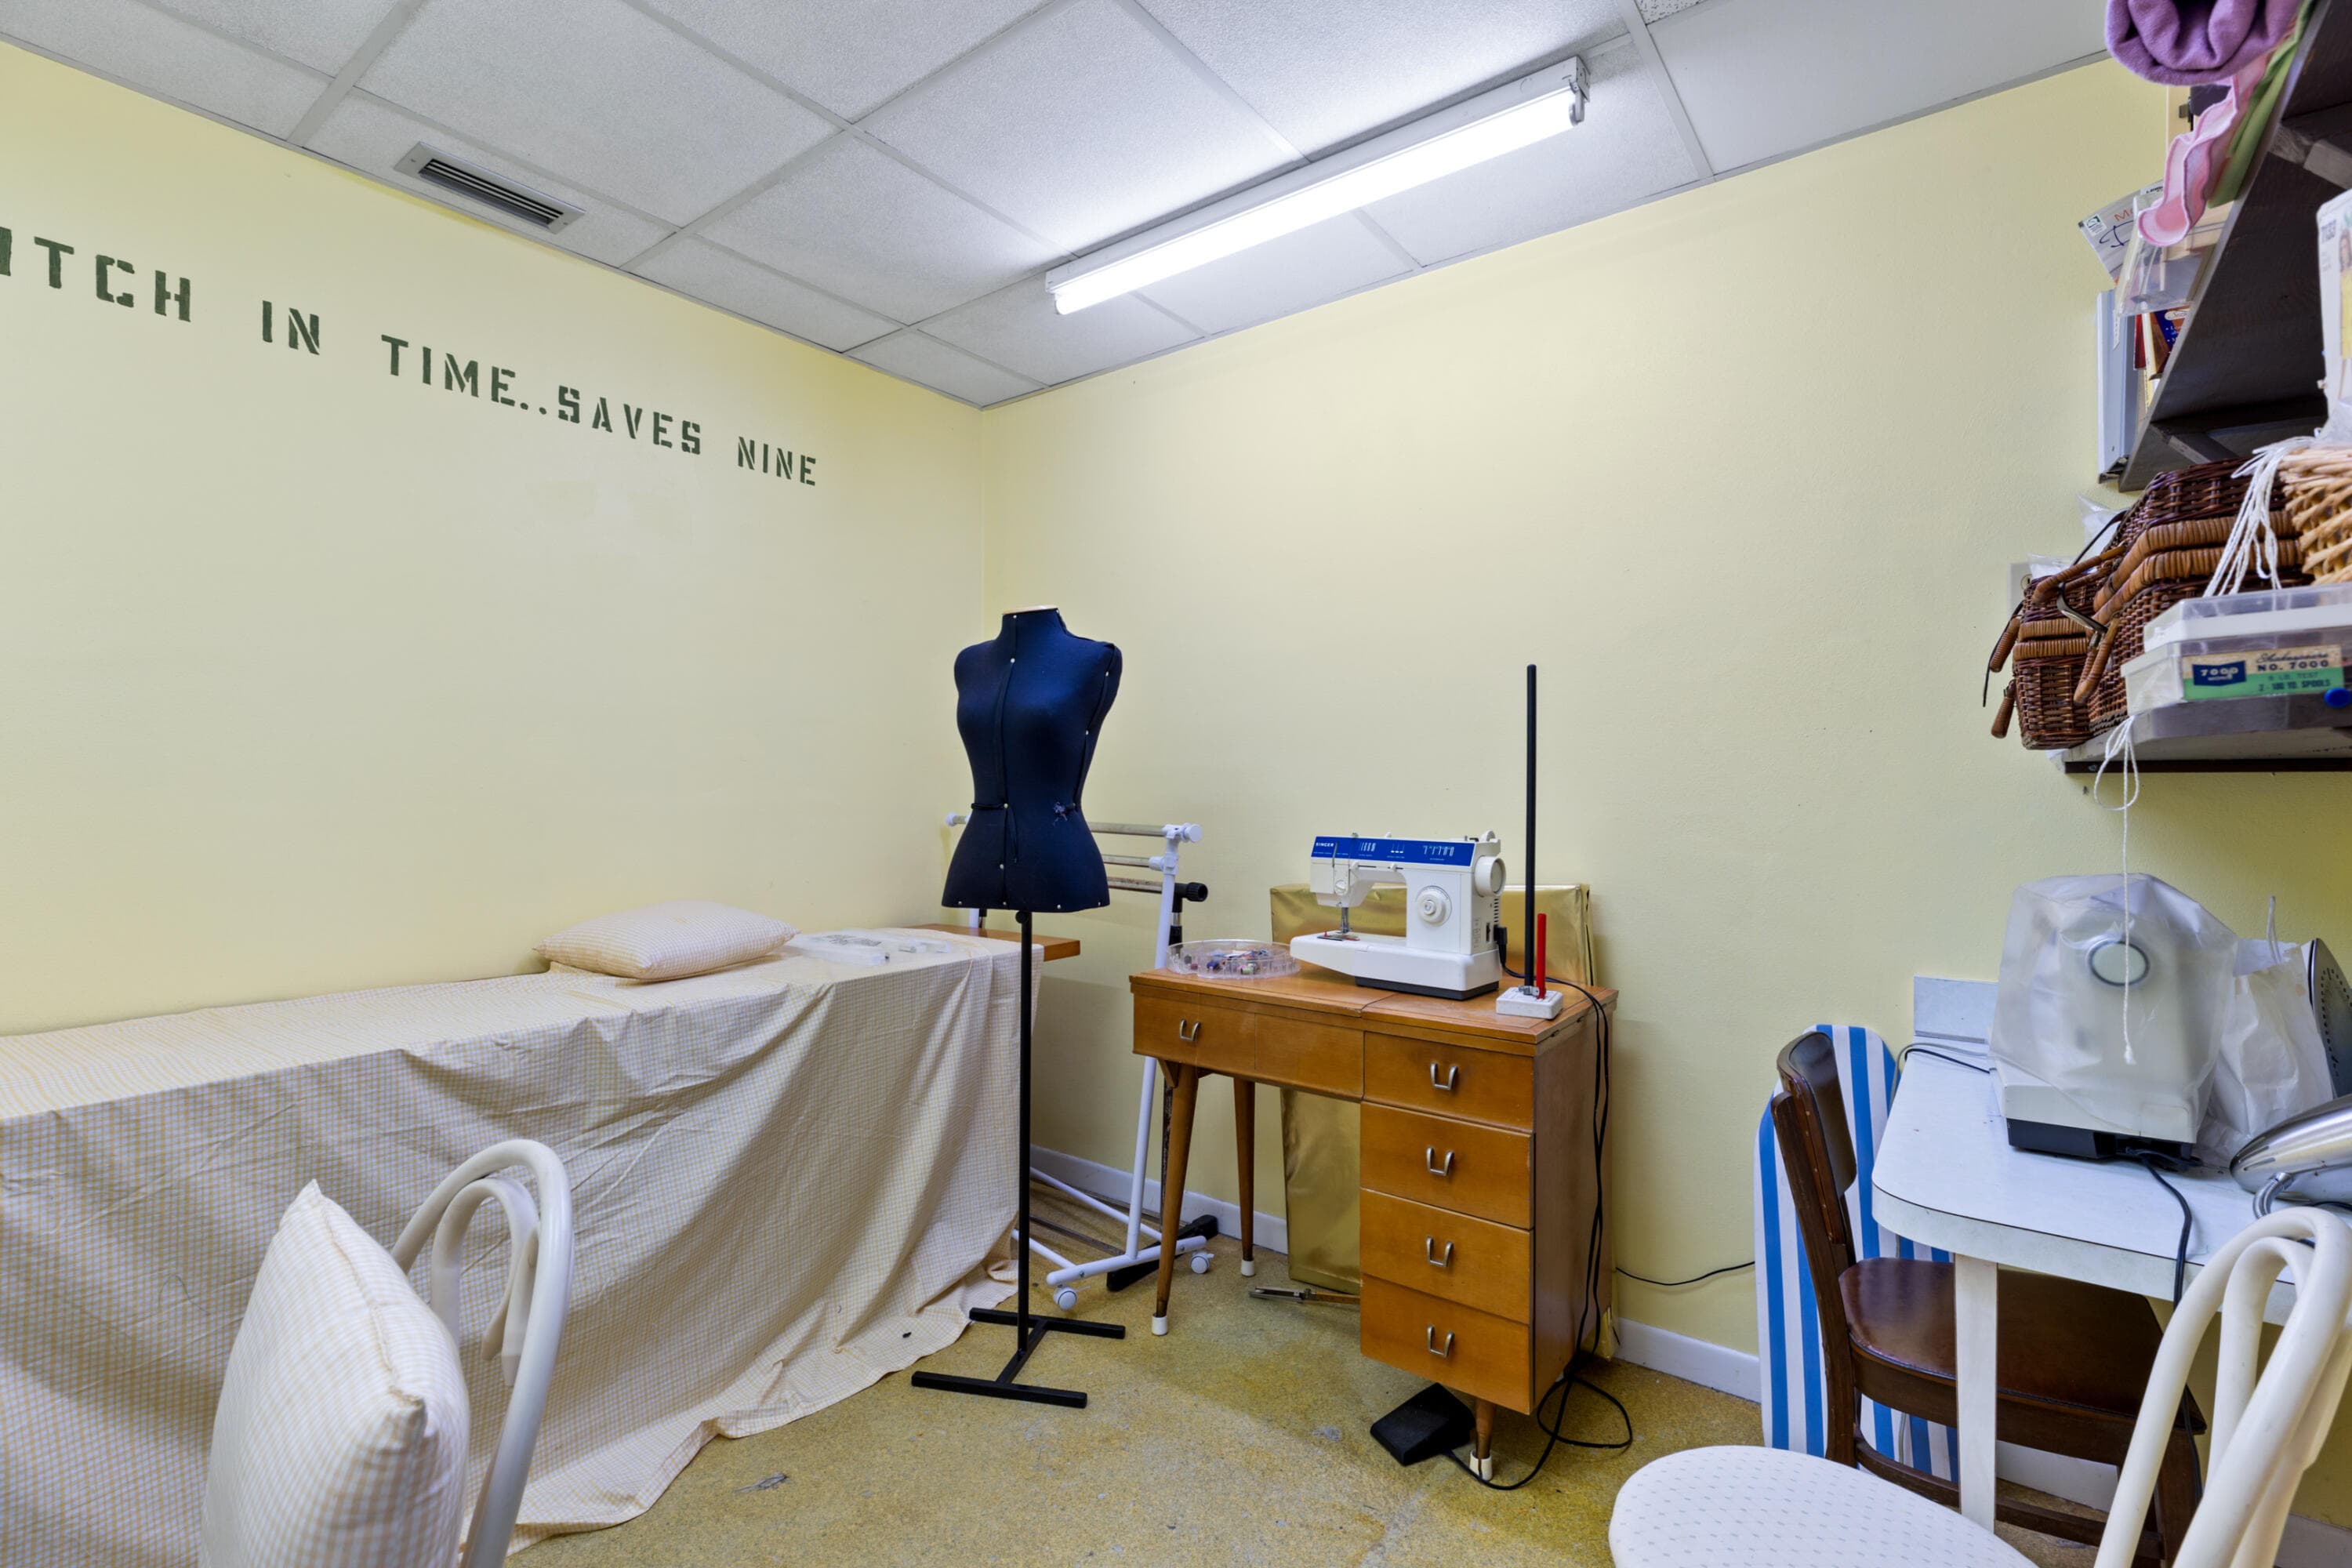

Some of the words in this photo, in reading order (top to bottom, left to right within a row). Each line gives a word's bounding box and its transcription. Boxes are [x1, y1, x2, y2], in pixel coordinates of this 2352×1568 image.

[262, 299, 321, 356] IN
[737, 435, 817, 487] NINE
[2199, 666, 2239, 677] 7000
[2257, 663, 2284, 672] NO.
[2288, 659, 2329, 670] 7000
